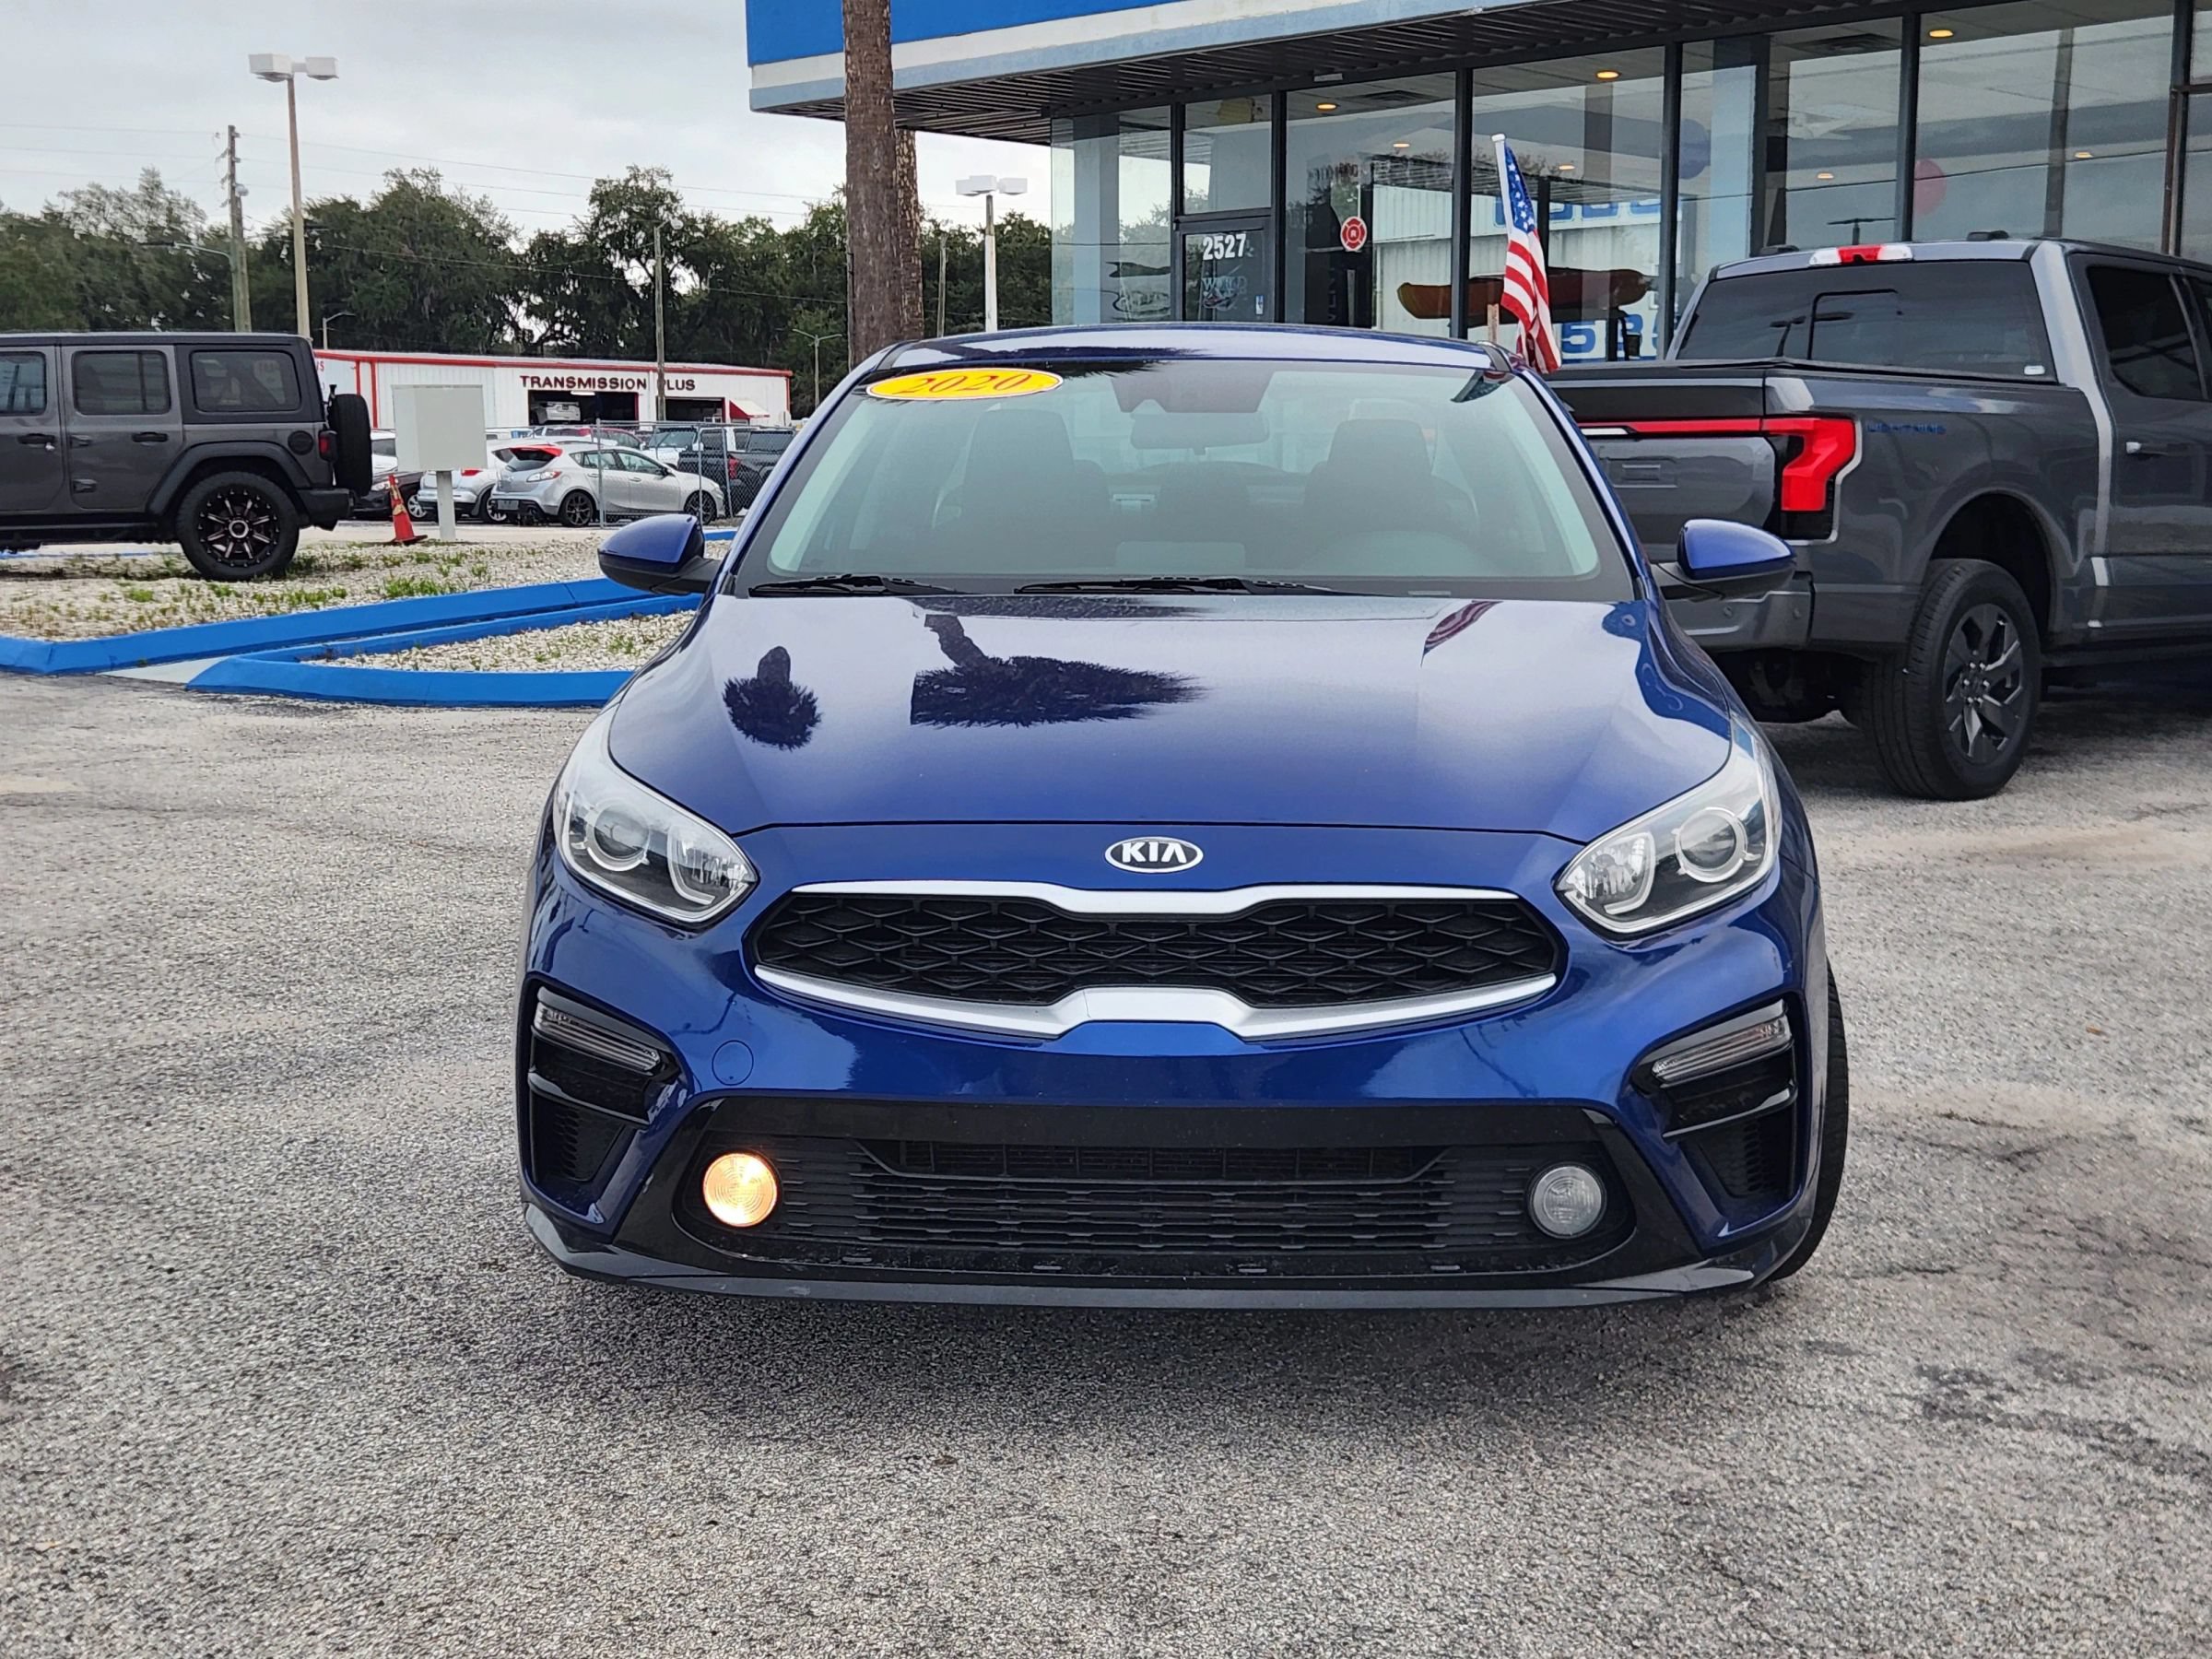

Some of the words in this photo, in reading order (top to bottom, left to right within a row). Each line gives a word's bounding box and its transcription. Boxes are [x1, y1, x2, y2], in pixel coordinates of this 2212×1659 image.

[1203, 233, 1246, 261] 2527
[520, 375, 646, 390] TRANSMISSION
[893, 373, 1032, 394] 2020
[1121, 841, 1187, 864] KIA
